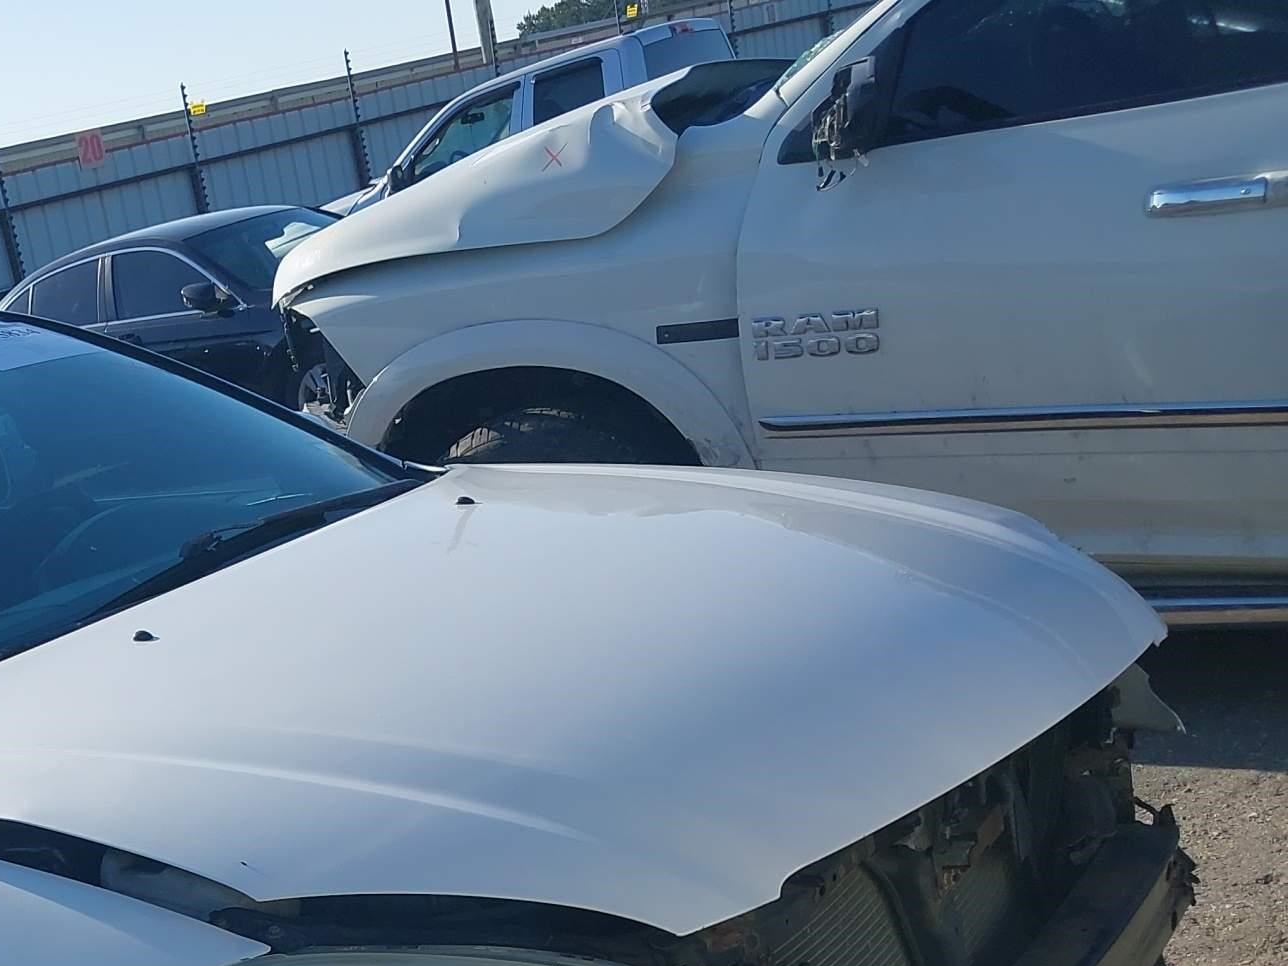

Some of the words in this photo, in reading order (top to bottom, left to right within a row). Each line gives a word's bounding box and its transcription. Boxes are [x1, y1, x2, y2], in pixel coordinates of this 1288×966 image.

[80, 134, 103, 163] 20
[751, 308, 879, 338] RAM
[752, 333, 880, 360] 1500
